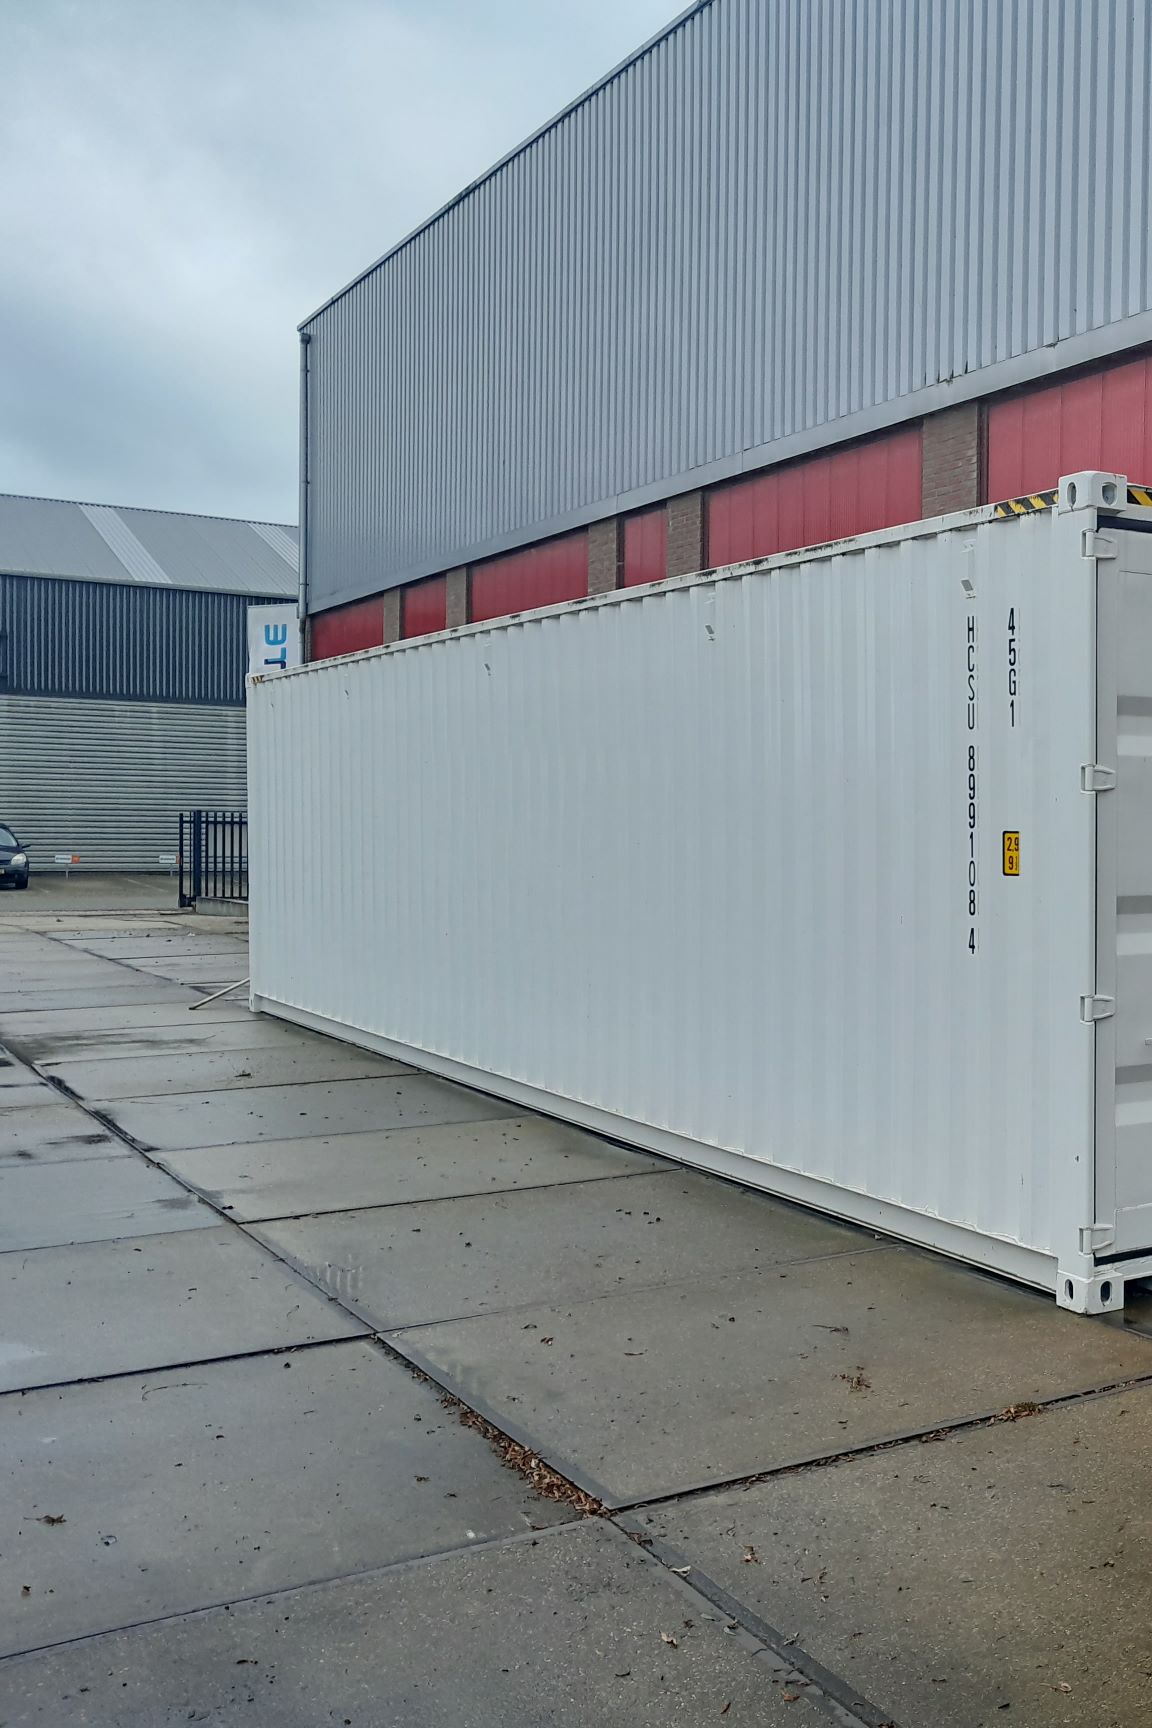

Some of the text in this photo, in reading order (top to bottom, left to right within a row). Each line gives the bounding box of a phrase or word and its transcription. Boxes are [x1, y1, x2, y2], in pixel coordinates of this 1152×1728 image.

[1007, 607, 1017, 728] 45G1
[967, 615, 976, 955] HCSU 899108 4
